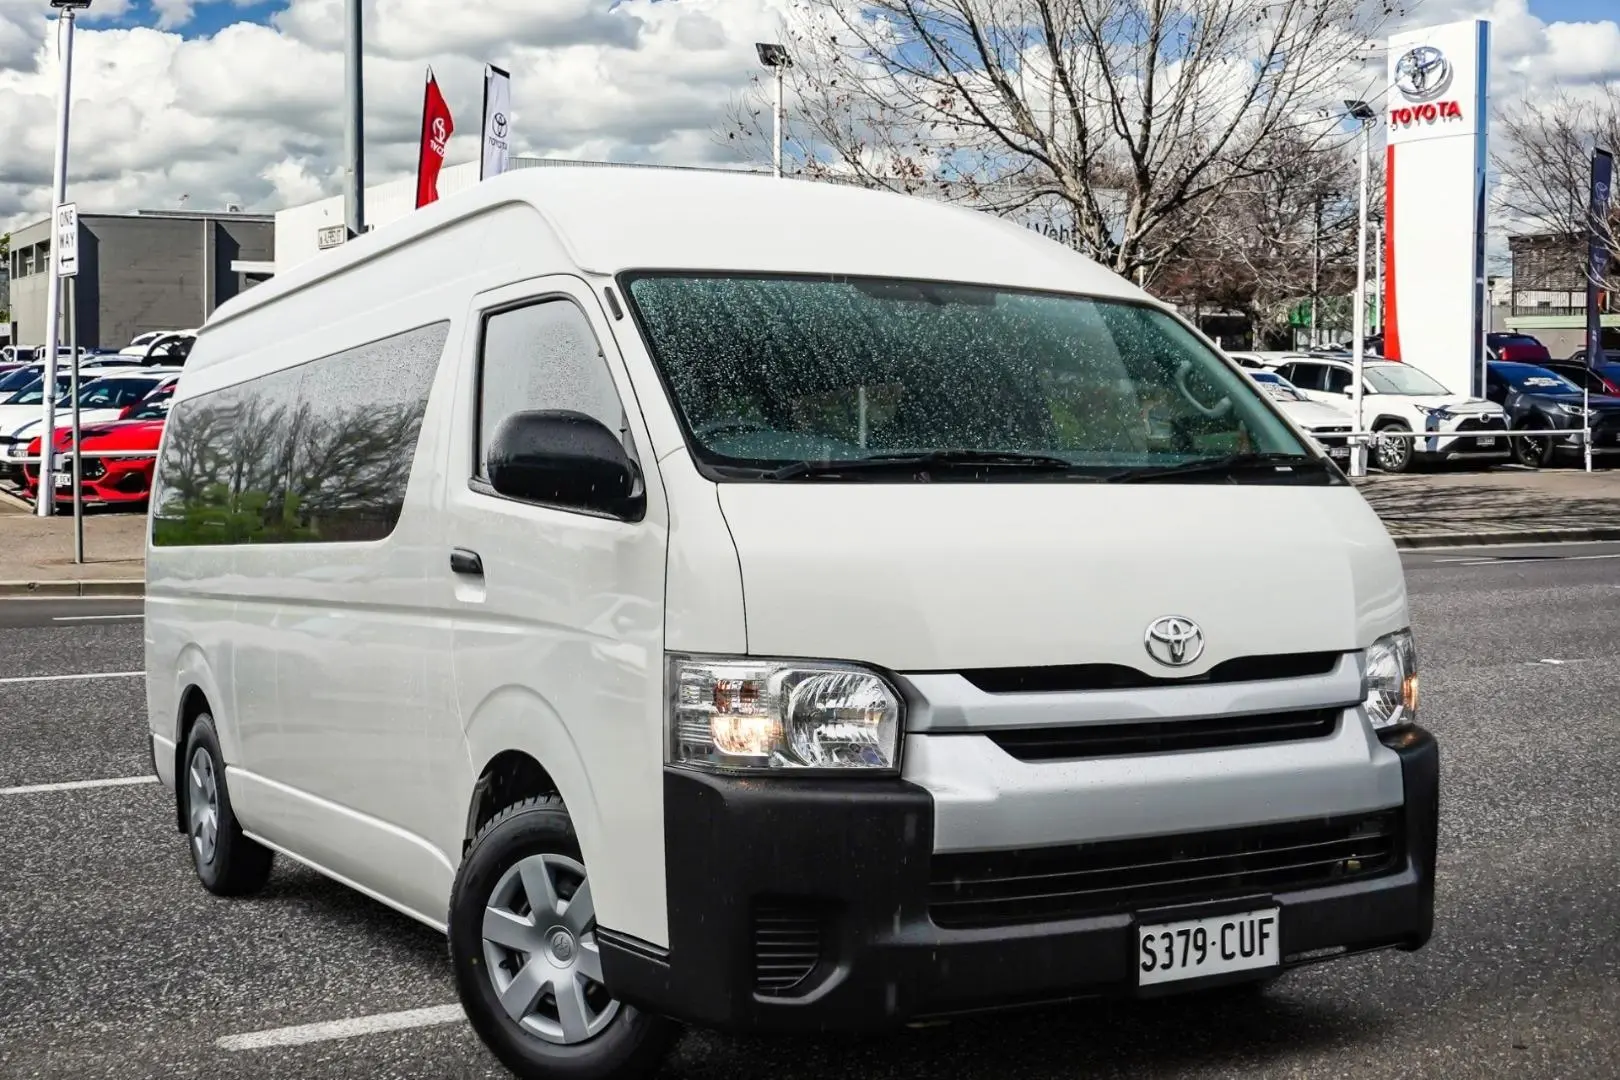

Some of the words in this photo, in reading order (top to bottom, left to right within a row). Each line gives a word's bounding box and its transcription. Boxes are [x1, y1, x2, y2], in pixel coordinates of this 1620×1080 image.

[1389, 100, 1461, 125] TOYOTA
[60, 209, 74, 228] ONE
[60, 231, 75, 249] WAY
